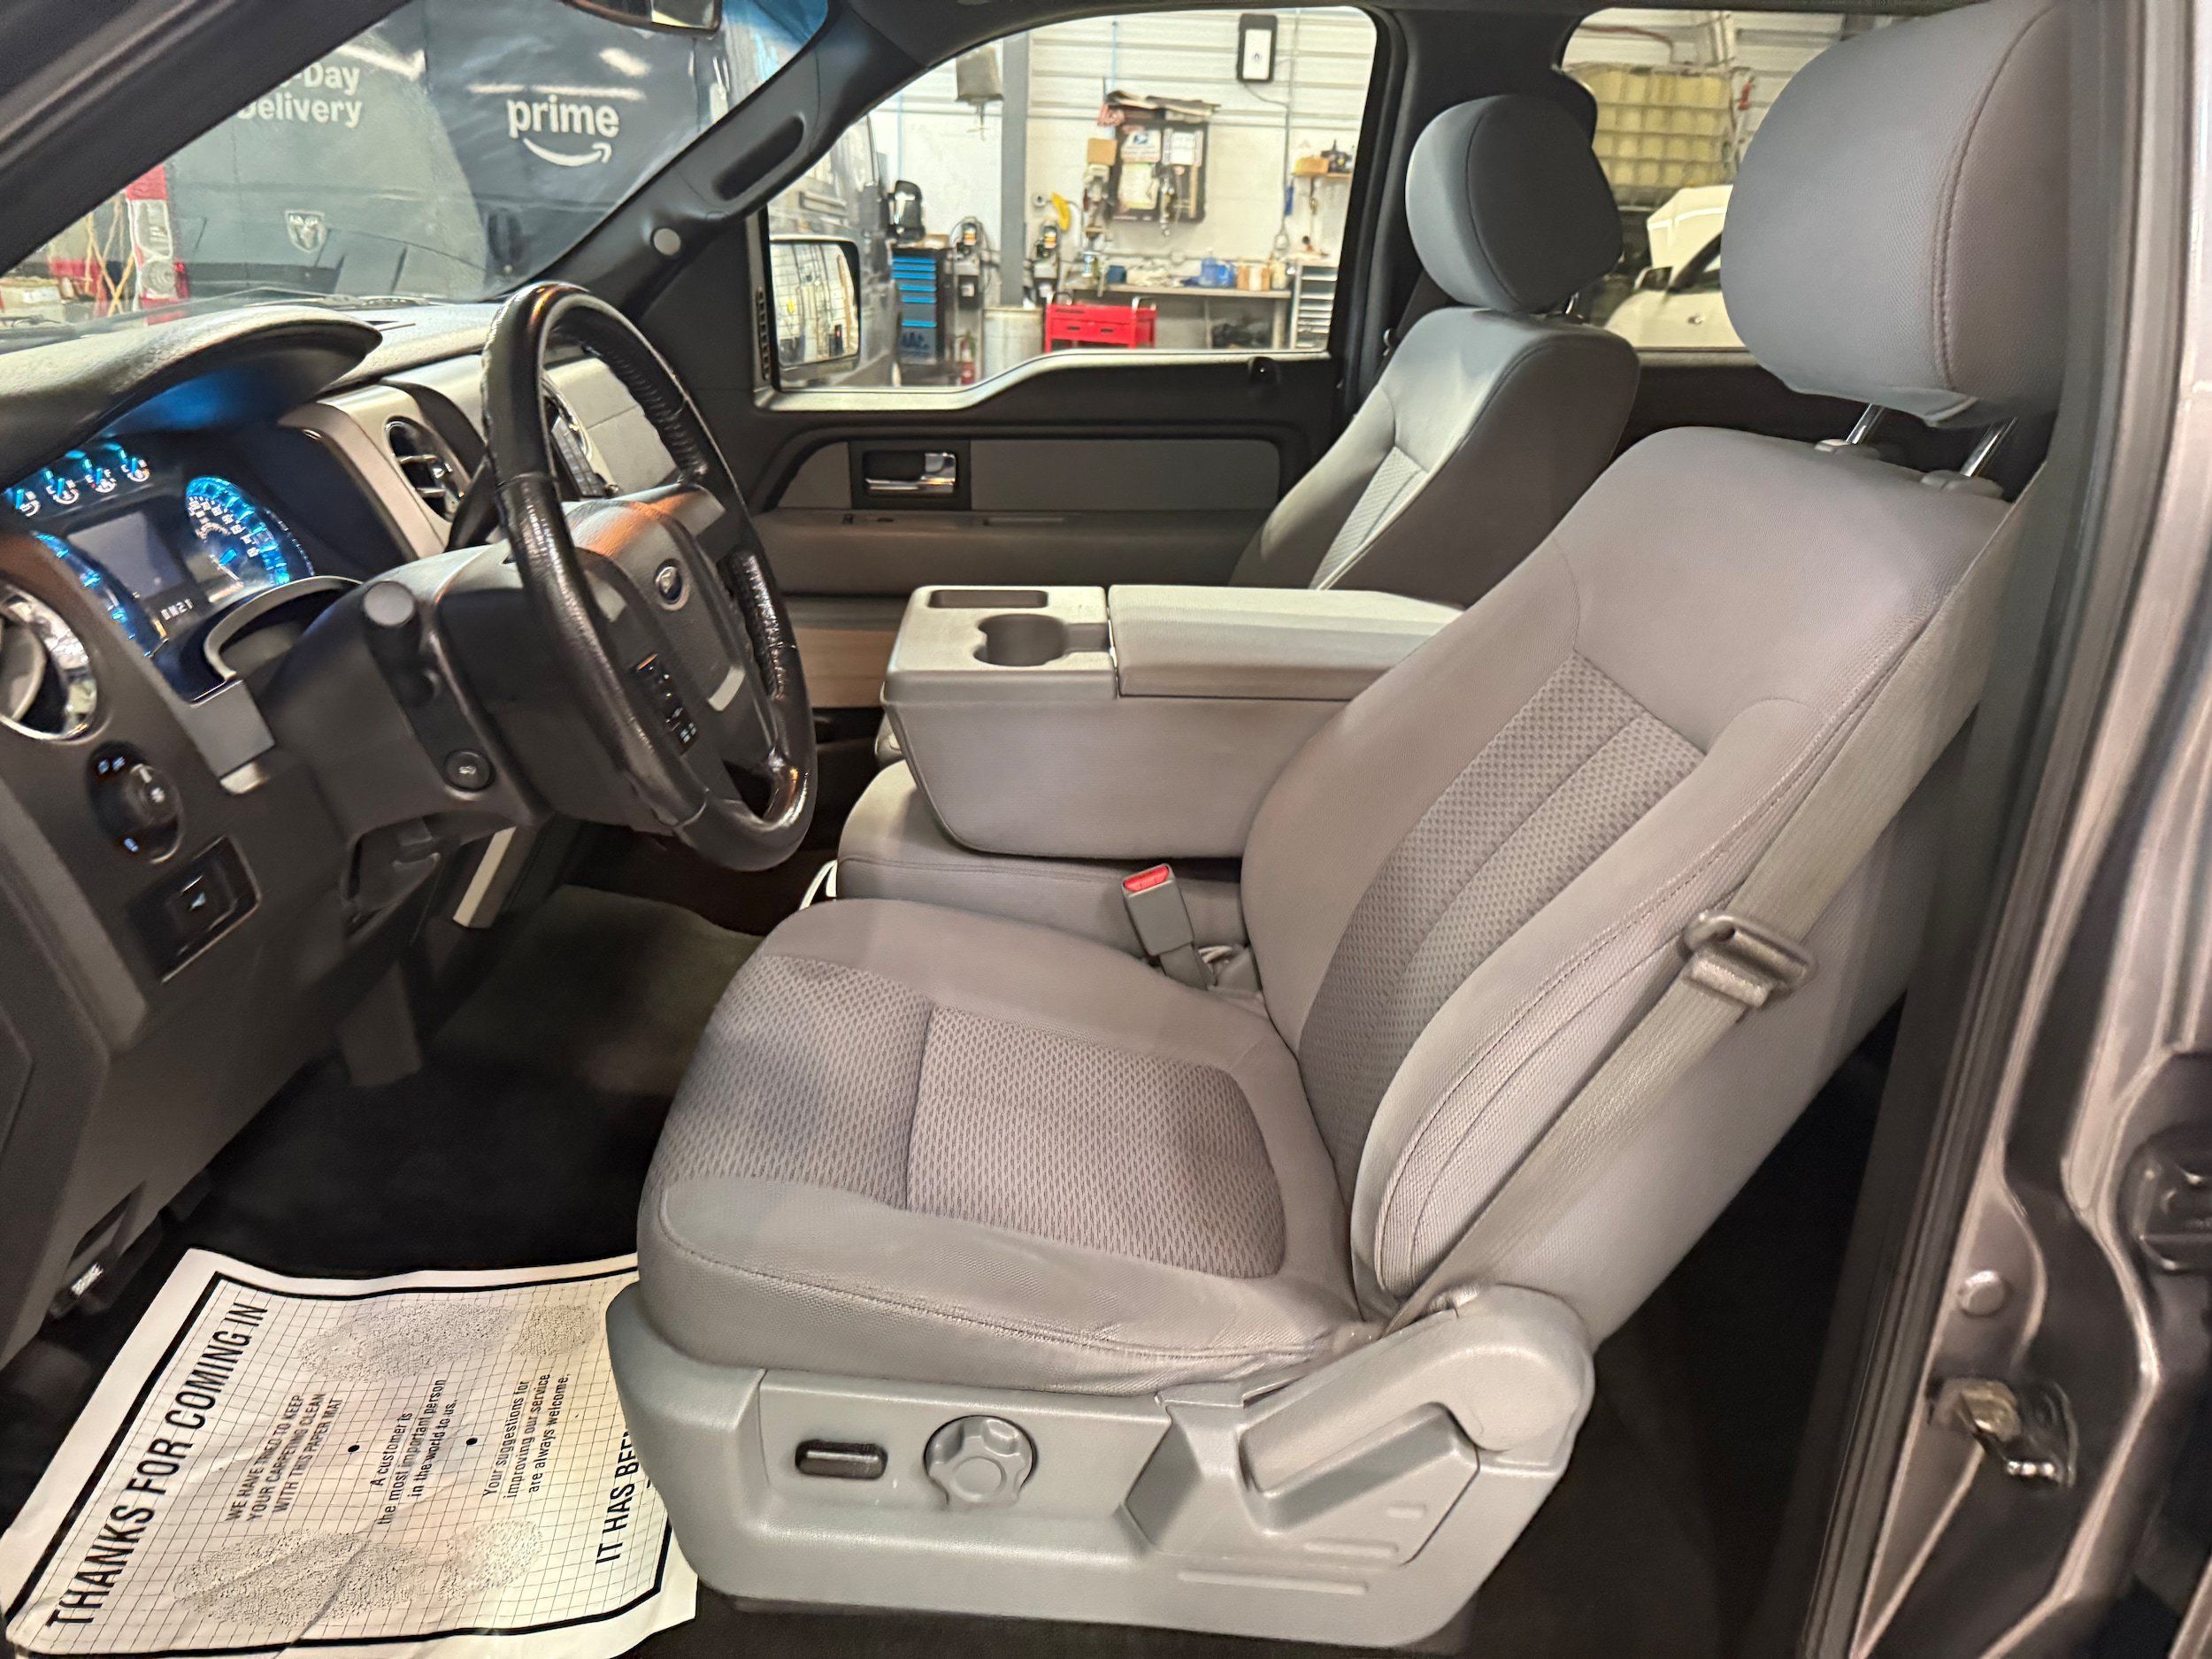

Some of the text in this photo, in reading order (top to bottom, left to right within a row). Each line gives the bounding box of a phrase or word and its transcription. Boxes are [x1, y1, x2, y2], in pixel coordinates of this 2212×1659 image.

[506, 94, 619, 139] prime
[45, 1302, 268, 1627] THANKS FOR COMING IN
[227, 1395, 304, 1521] WE HAVE TRIED TO KEEP
[247, 1394, 326, 1521] YOUR CARPETING CLEAN
[273, 1398, 343, 1513] WITH THIS PAPER MAT
[370, 1412, 413, 1486] A customer is
[377, 1379, 447, 1525] the most important person
[407, 1399, 458, 1497] in the world to us.
[482, 1380, 530, 1497] Your suggestions for
[503, 1374, 551, 1499] improving our service
[528, 1373, 571, 1494] are always welcome.
[595, 1431, 640, 1565] IT HAS BE
